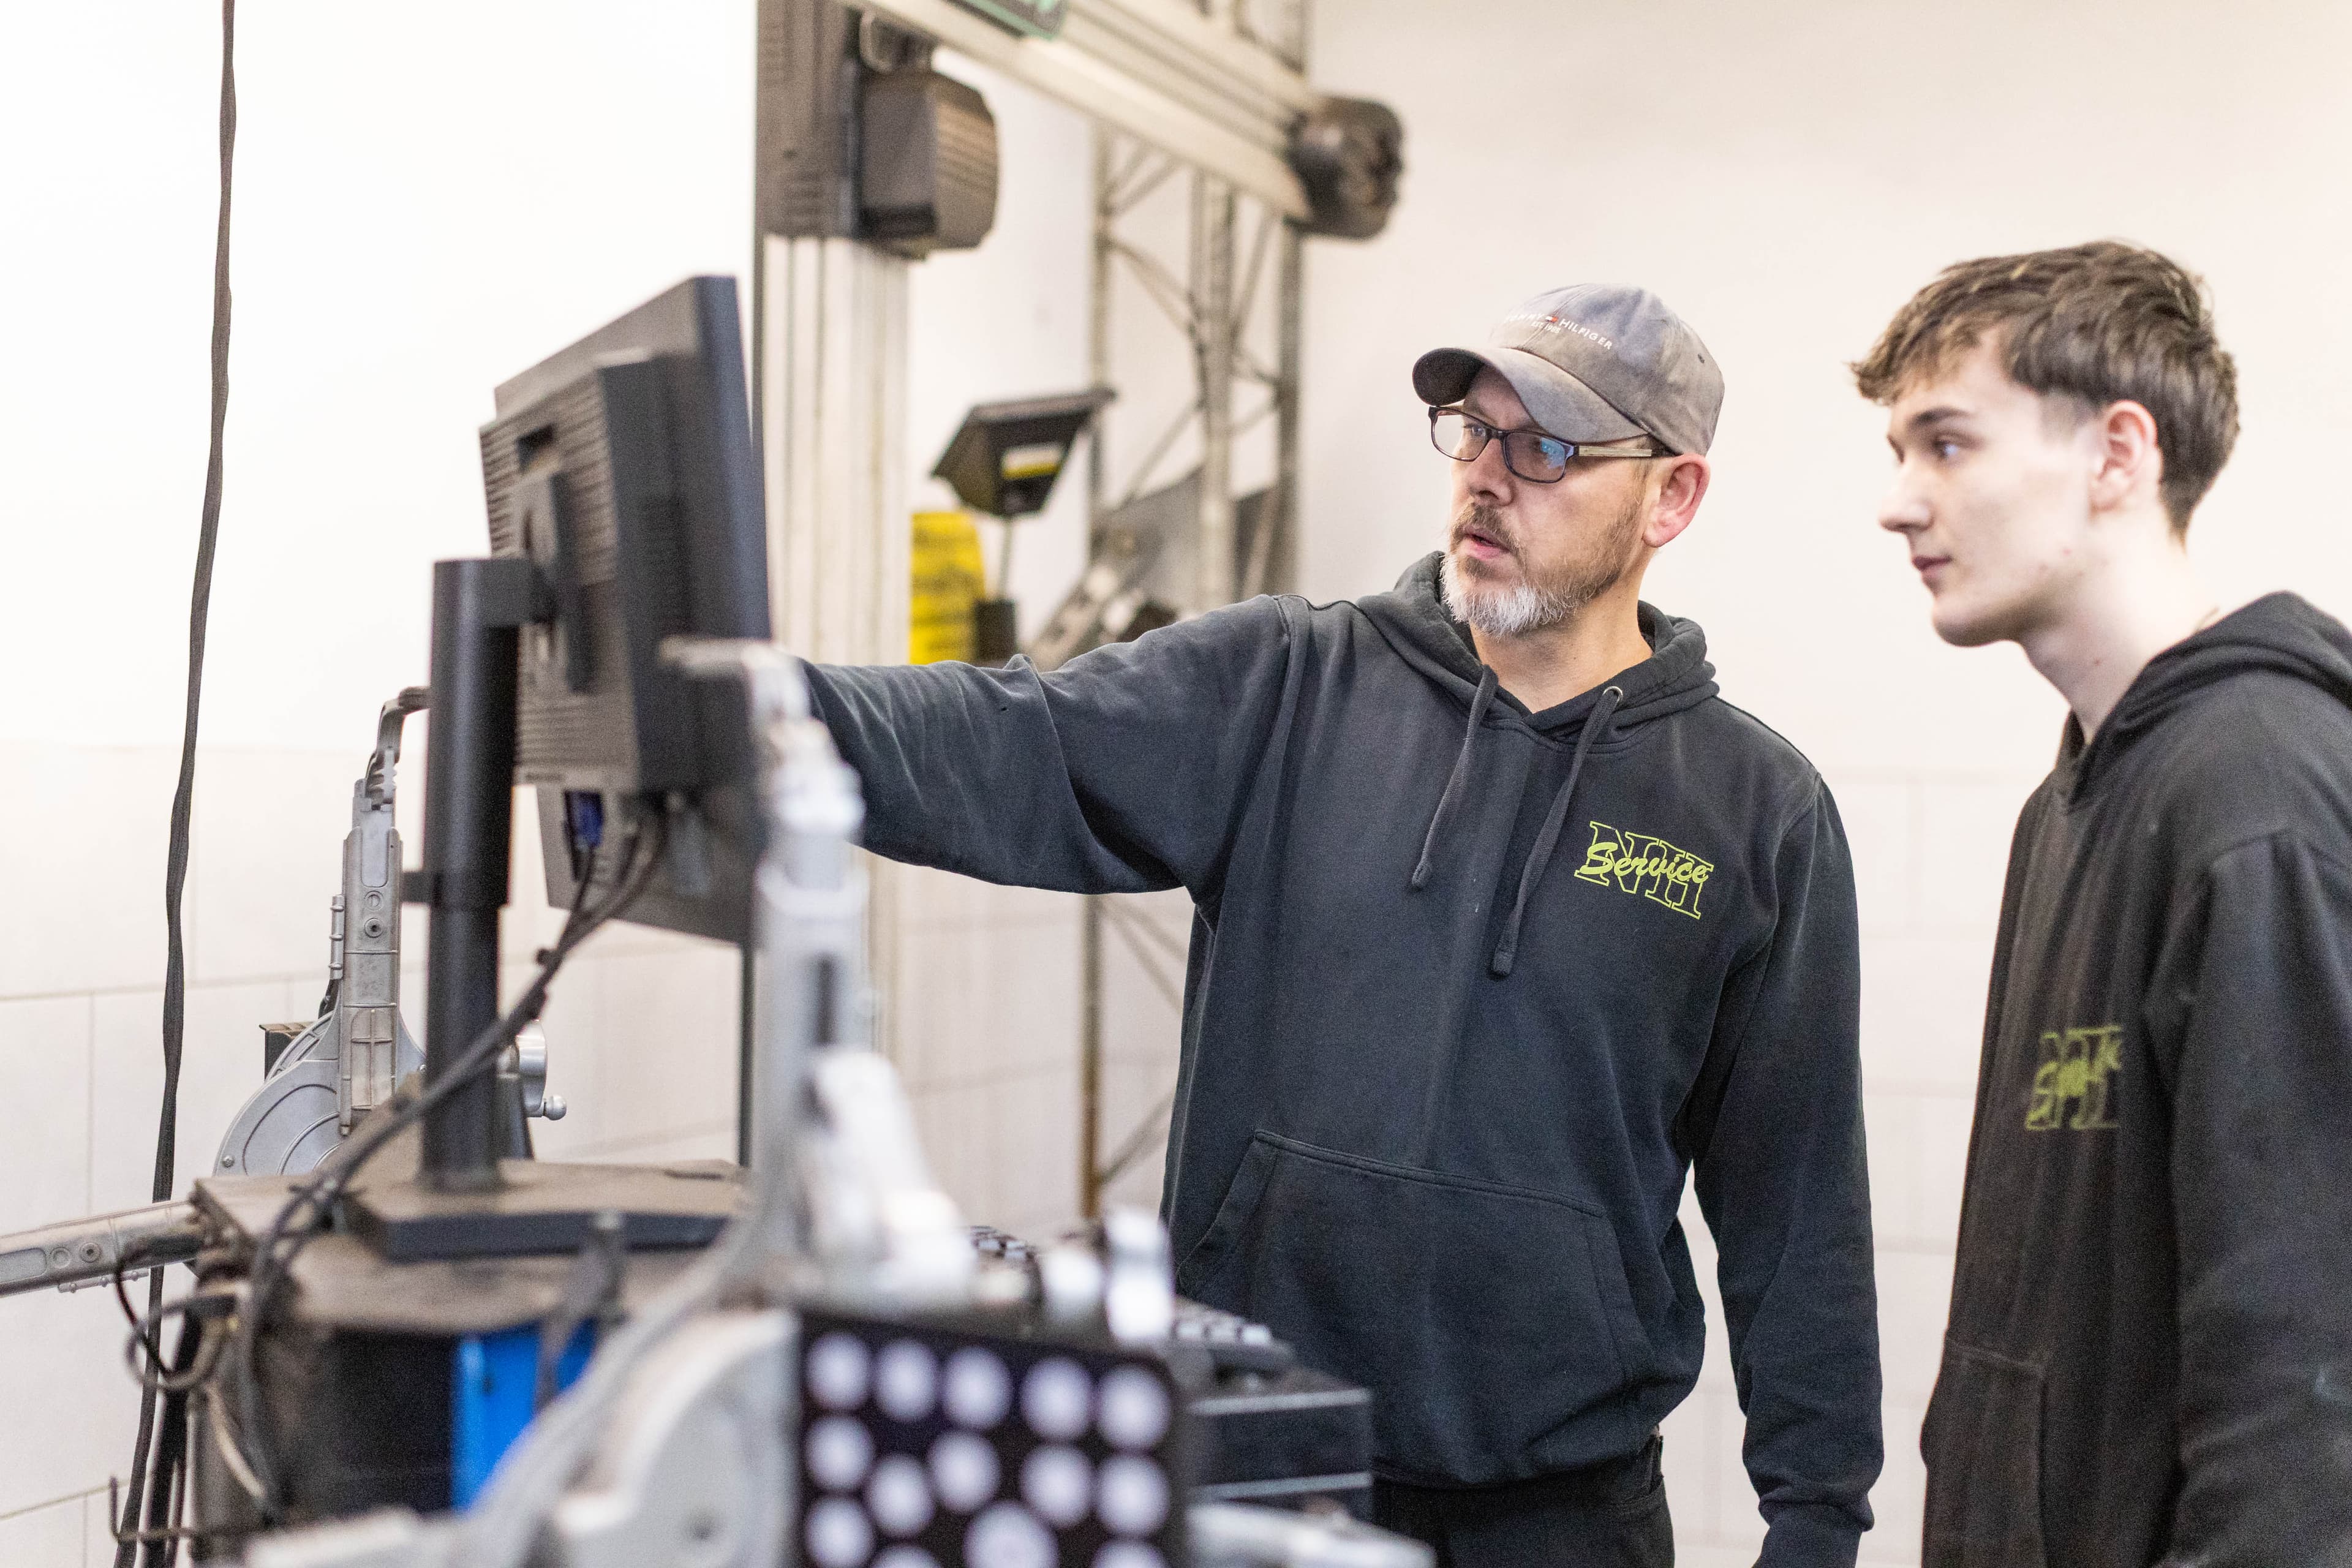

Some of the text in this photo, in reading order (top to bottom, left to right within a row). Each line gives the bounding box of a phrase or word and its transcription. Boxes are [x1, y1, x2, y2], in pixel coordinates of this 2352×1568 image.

[1504, 313, 1612, 350] MMY HILFIGER
[1580, 842, 1709, 883] Service
